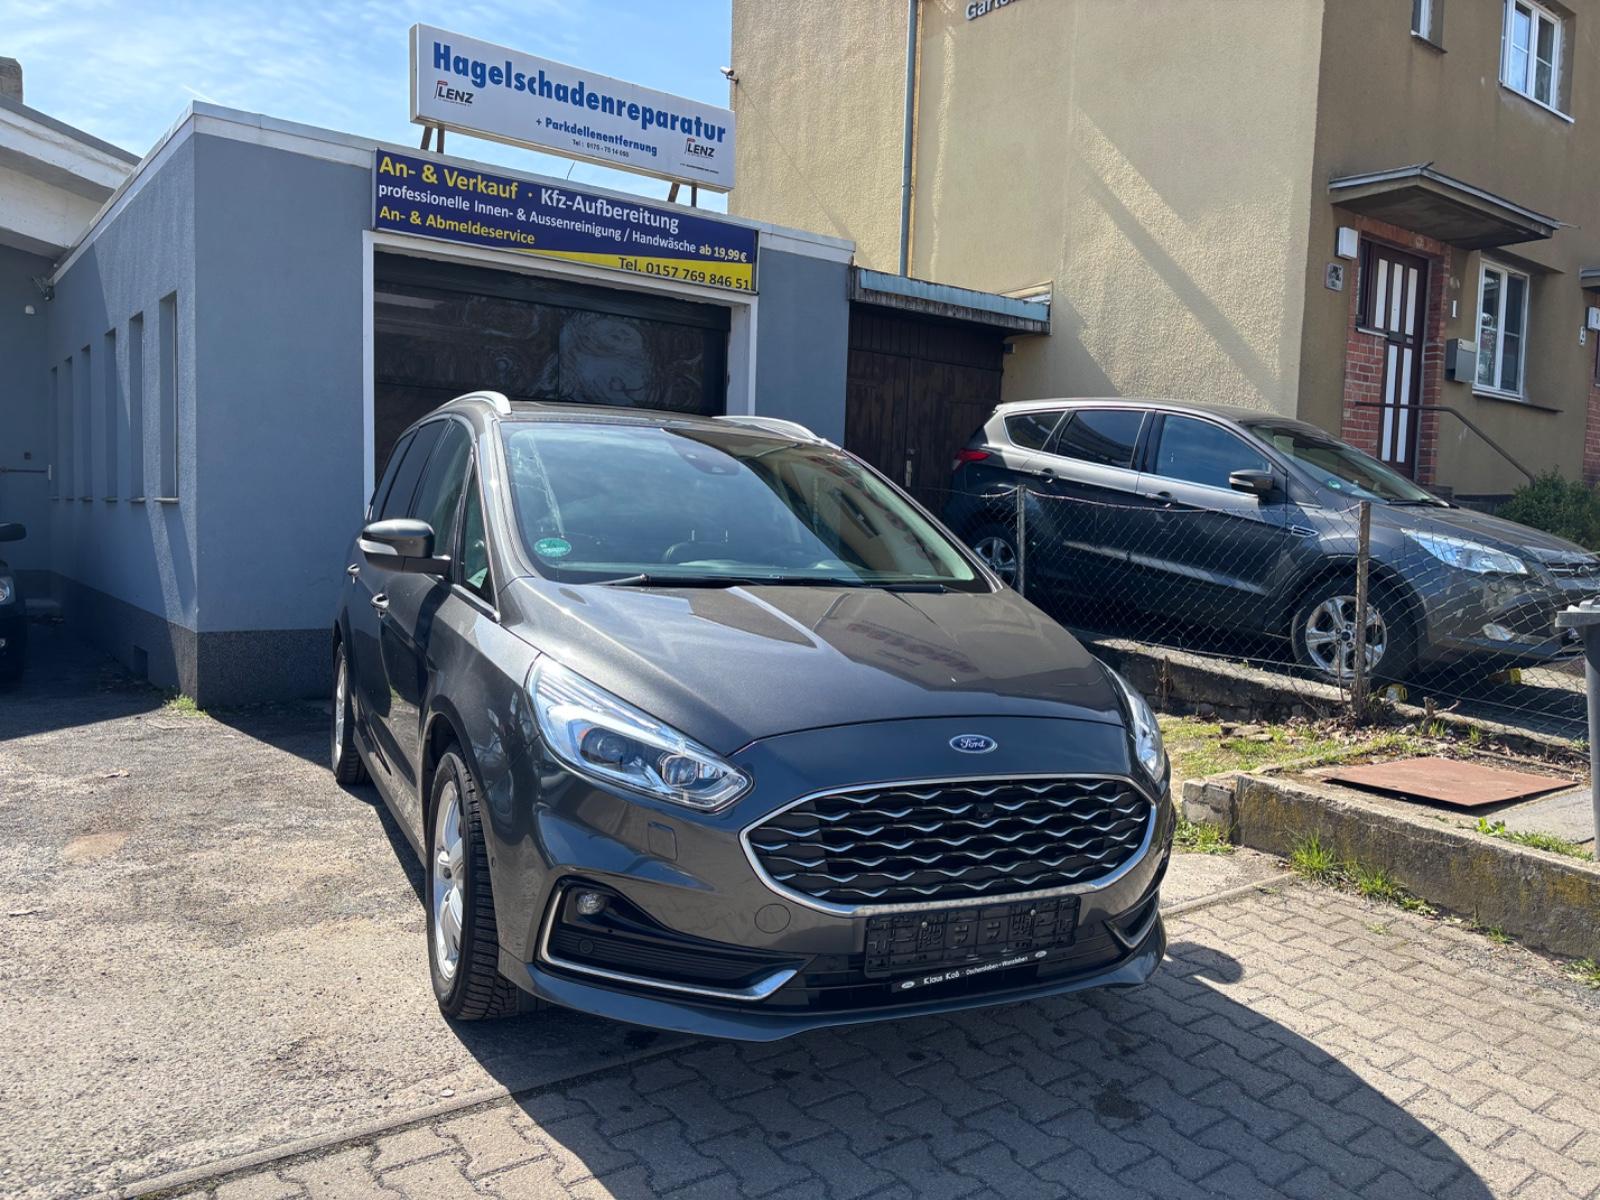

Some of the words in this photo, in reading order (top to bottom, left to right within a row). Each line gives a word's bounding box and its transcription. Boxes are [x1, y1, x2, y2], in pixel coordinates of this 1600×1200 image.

[433, 41, 726, 143] Hagelschadenreparatur
[437, 86, 474, 104] LENZ
[545, 117, 658, 157] Parkdellenentfernung
[687, 143, 715, 158] LENZ
[379, 156, 416, 178] An-
[422, 164, 438, 184] &
[444, 169, 518, 199] Verkauf
[379, 184, 470, 211] professionelle
[474, 200, 513, 218] Innen-
[516, 208, 526, 221] &
[529, 211, 622, 242] Aussenreinigung
[632, 230, 697, 253] Handwäsche
[699, 244, 711, 256] ab
[379, 205, 406, 221] An-
[409, 210, 422, 225] &
[426, 213, 535, 245] Abmeldeservice
[540, 188, 679, 234] Kfz-Aufbereitung
[618, 257, 641, 273] Tel.
[646, 263, 678, 278] 0157
[683, 268, 705, 283] 769
[709, 272, 732, 288] 846
[735, 278, 749, 290] 51
[960, 737, 985, 749] Ford
[923, 976, 943, 985] Klaus
